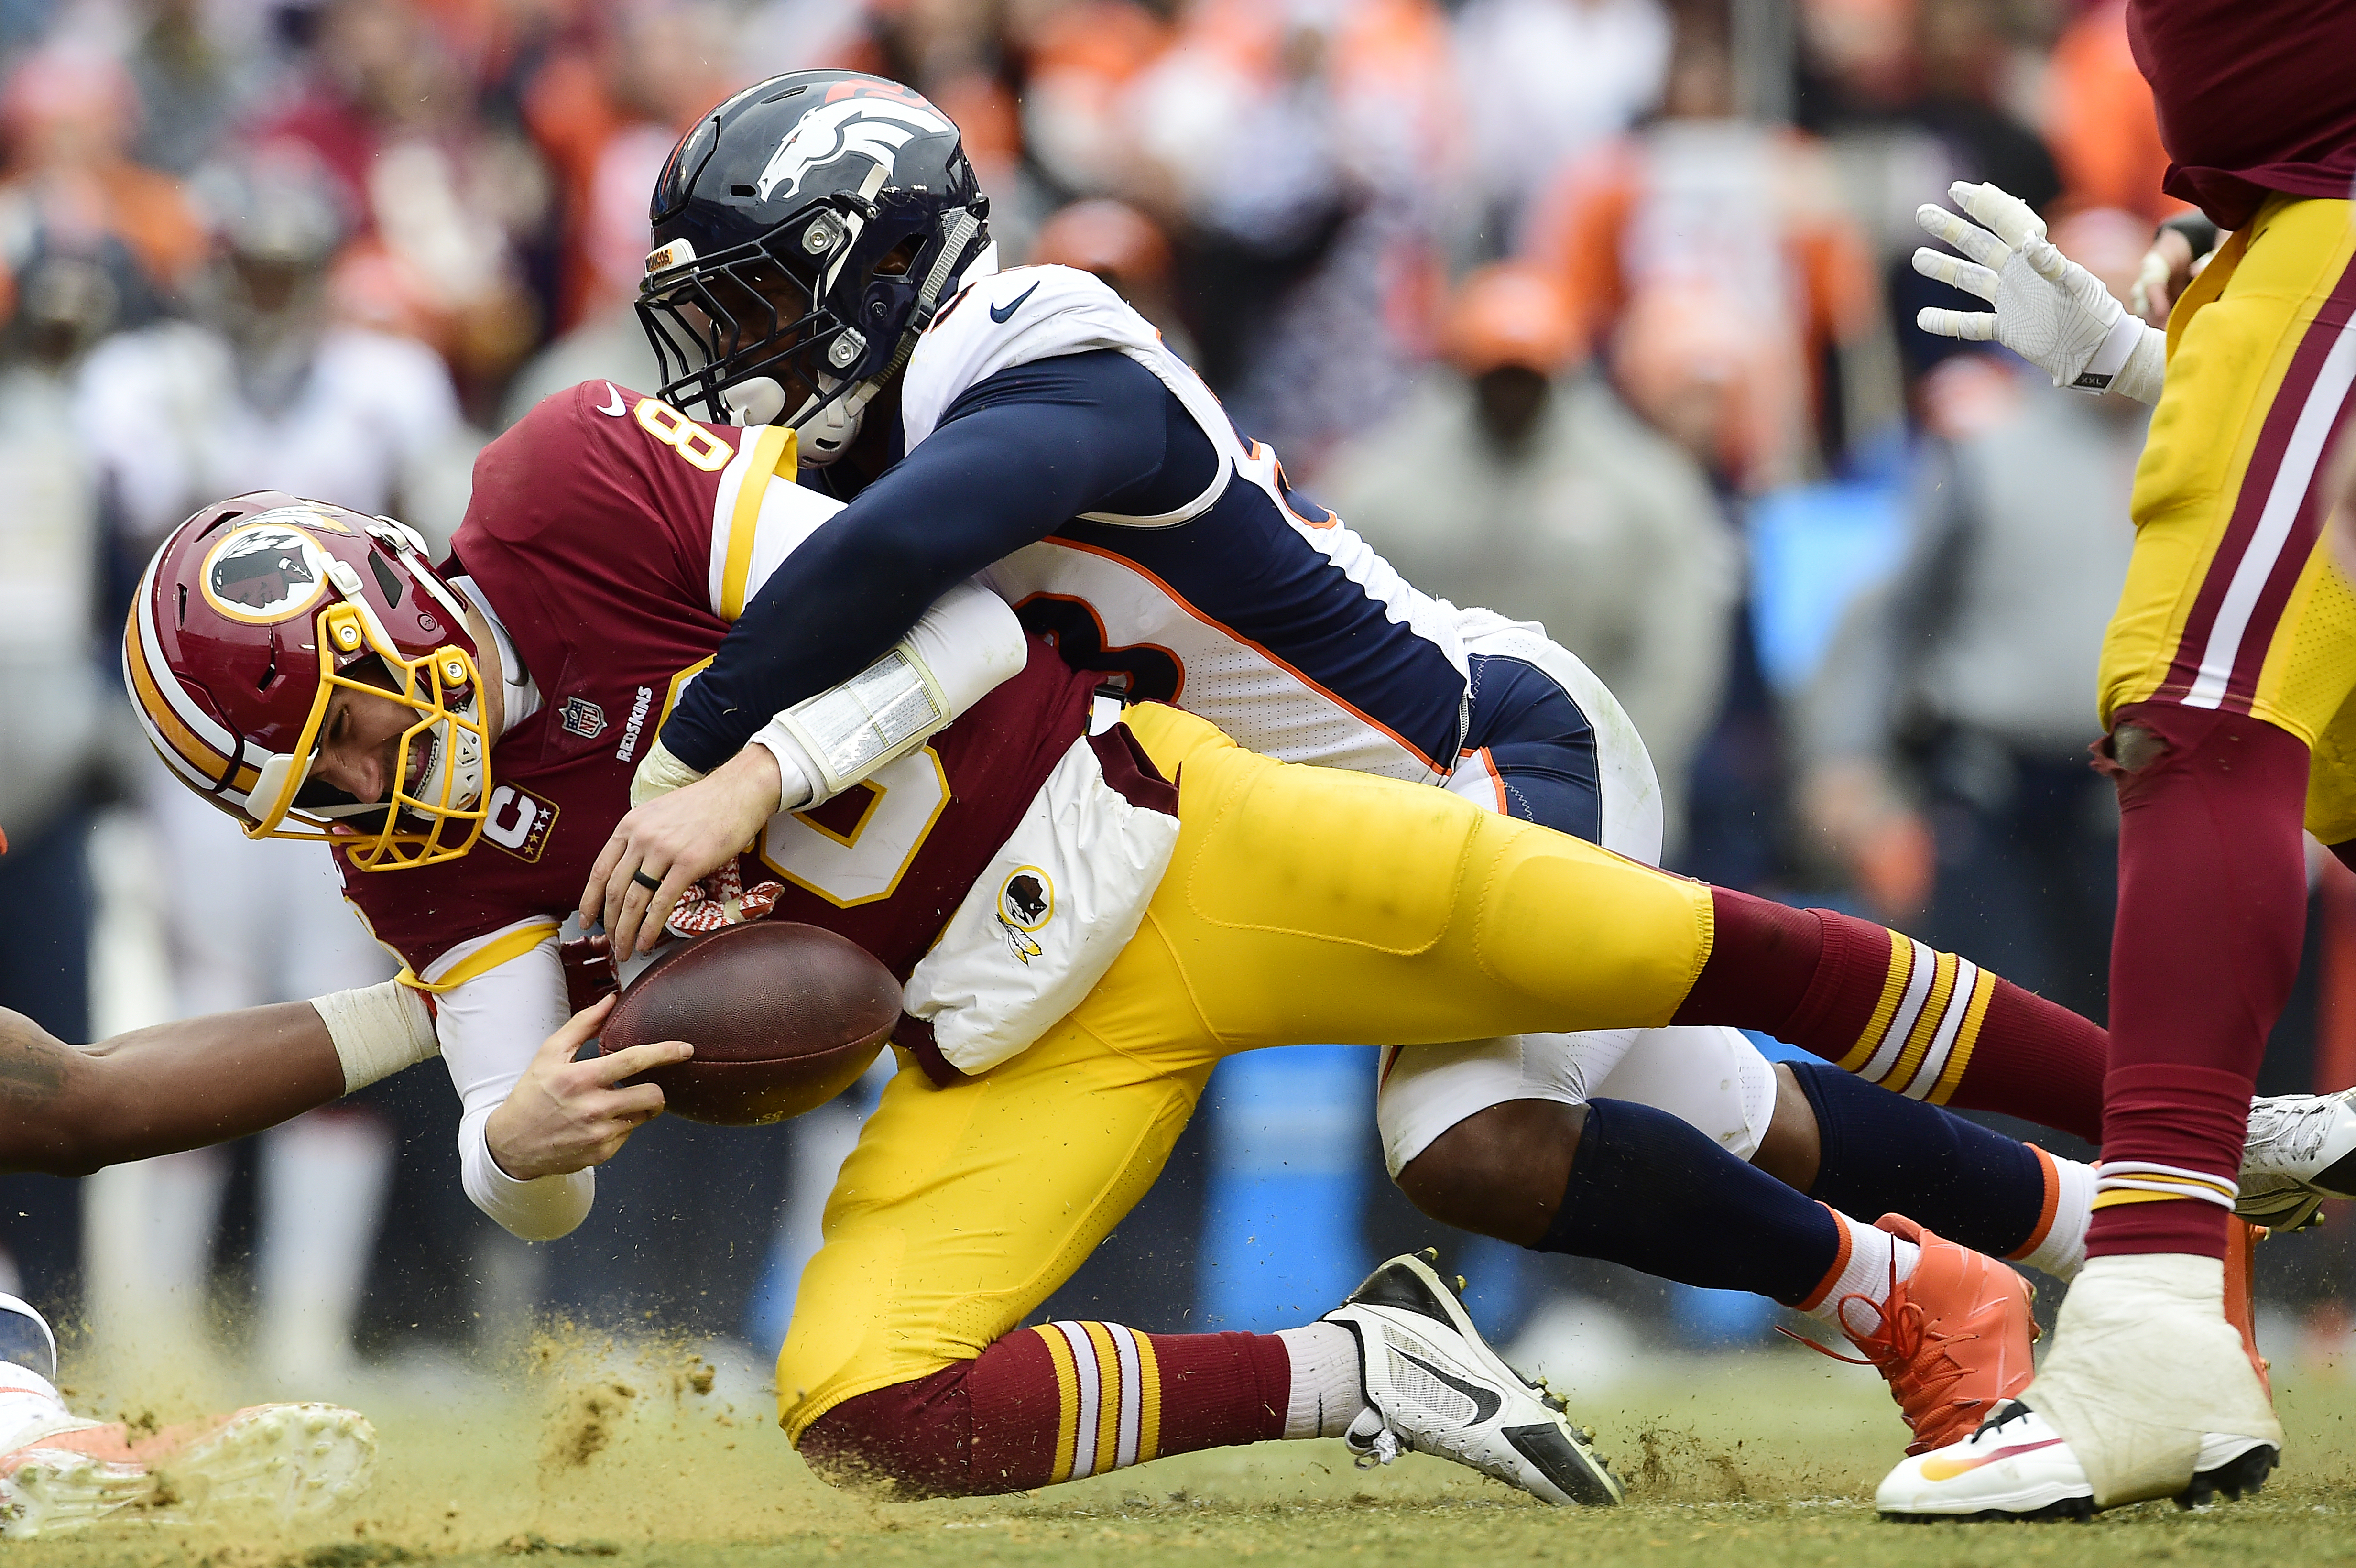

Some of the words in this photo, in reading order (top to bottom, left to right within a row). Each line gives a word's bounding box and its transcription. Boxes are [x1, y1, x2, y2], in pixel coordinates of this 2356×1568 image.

[2082, 377, 2102, 385] XXL
[633, 398, 735, 472] 8
[579, 709, 599, 733] NFL
[616, 686, 653, 763] REDSKINS
[482, 785, 537, 849] C
